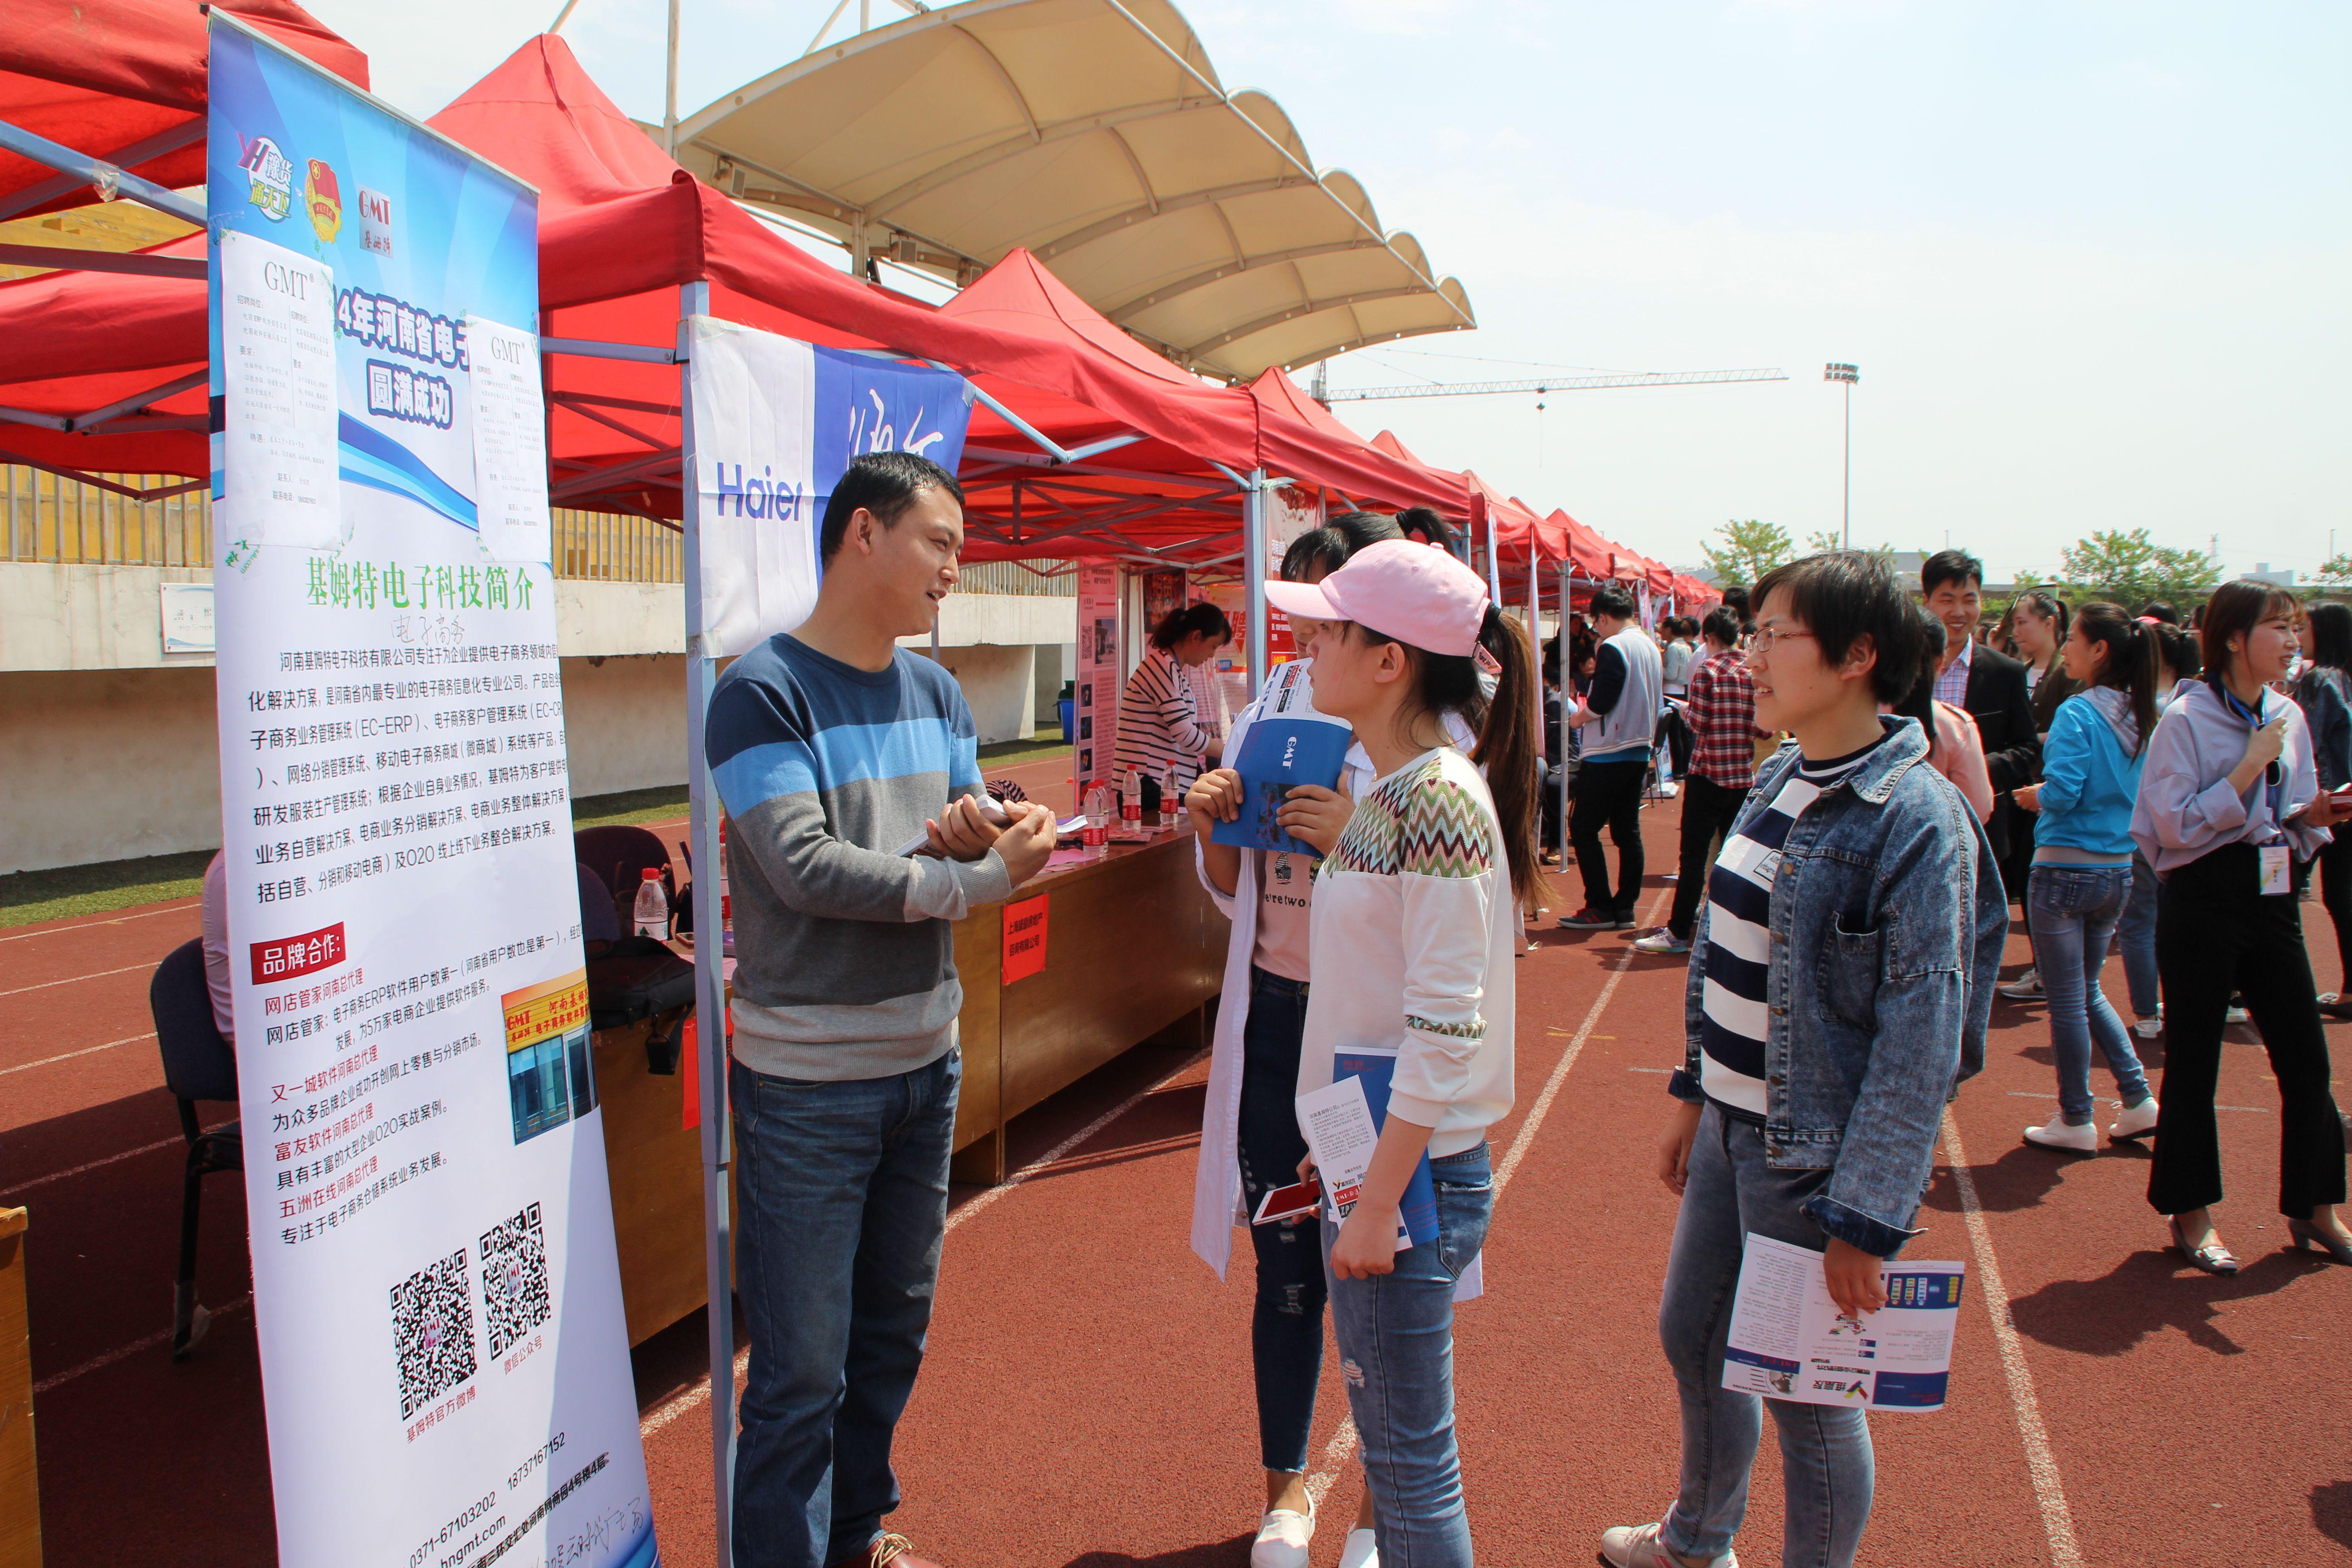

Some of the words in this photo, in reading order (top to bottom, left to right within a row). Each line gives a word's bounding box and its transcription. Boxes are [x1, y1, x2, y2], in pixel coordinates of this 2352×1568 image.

[248, 178, 291, 218] 通天下
[359, 191, 390, 225] GMT
[369, 363, 450, 425] 圆满成功
[717, 461, 804, 522] Haier
[305, 556, 534, 611] 基姆特电子科技简介
[280, 643, 559, 672] 河南基姆特电子科技有限公司专注于为企业提供电子商务领域内信
[248, 671, 562, 712] 化解决方案，是河南省内最专业的电子商务信息化专业公司。产品包含
[1282, 735, 1298, 770] GMT
[254, 758, 568, 827] 研发服装生产管理系统；根据企业自身业务情况，基姆特为客户提供电
[1265, 893, 1283, 904] e're
[1284, 895, 1306, 907] two
[265, 967, 364, 1016] 网店管家河南总代理
[506, 1009, 531, 1031] GMT
[270, 1044, 378, 1104] 又一城软件河南总代理
[274, 1102, 374, 1161] 富友软件河南总代理
[279, 1155, 378, 1219] 五洲在线河南总代理
[504, 1334, 543, 1376] 微信公众号
[407, 1384, 476, 1444] 基姆特官方微博
[507, 1431, 566, 1491] 18737167152
